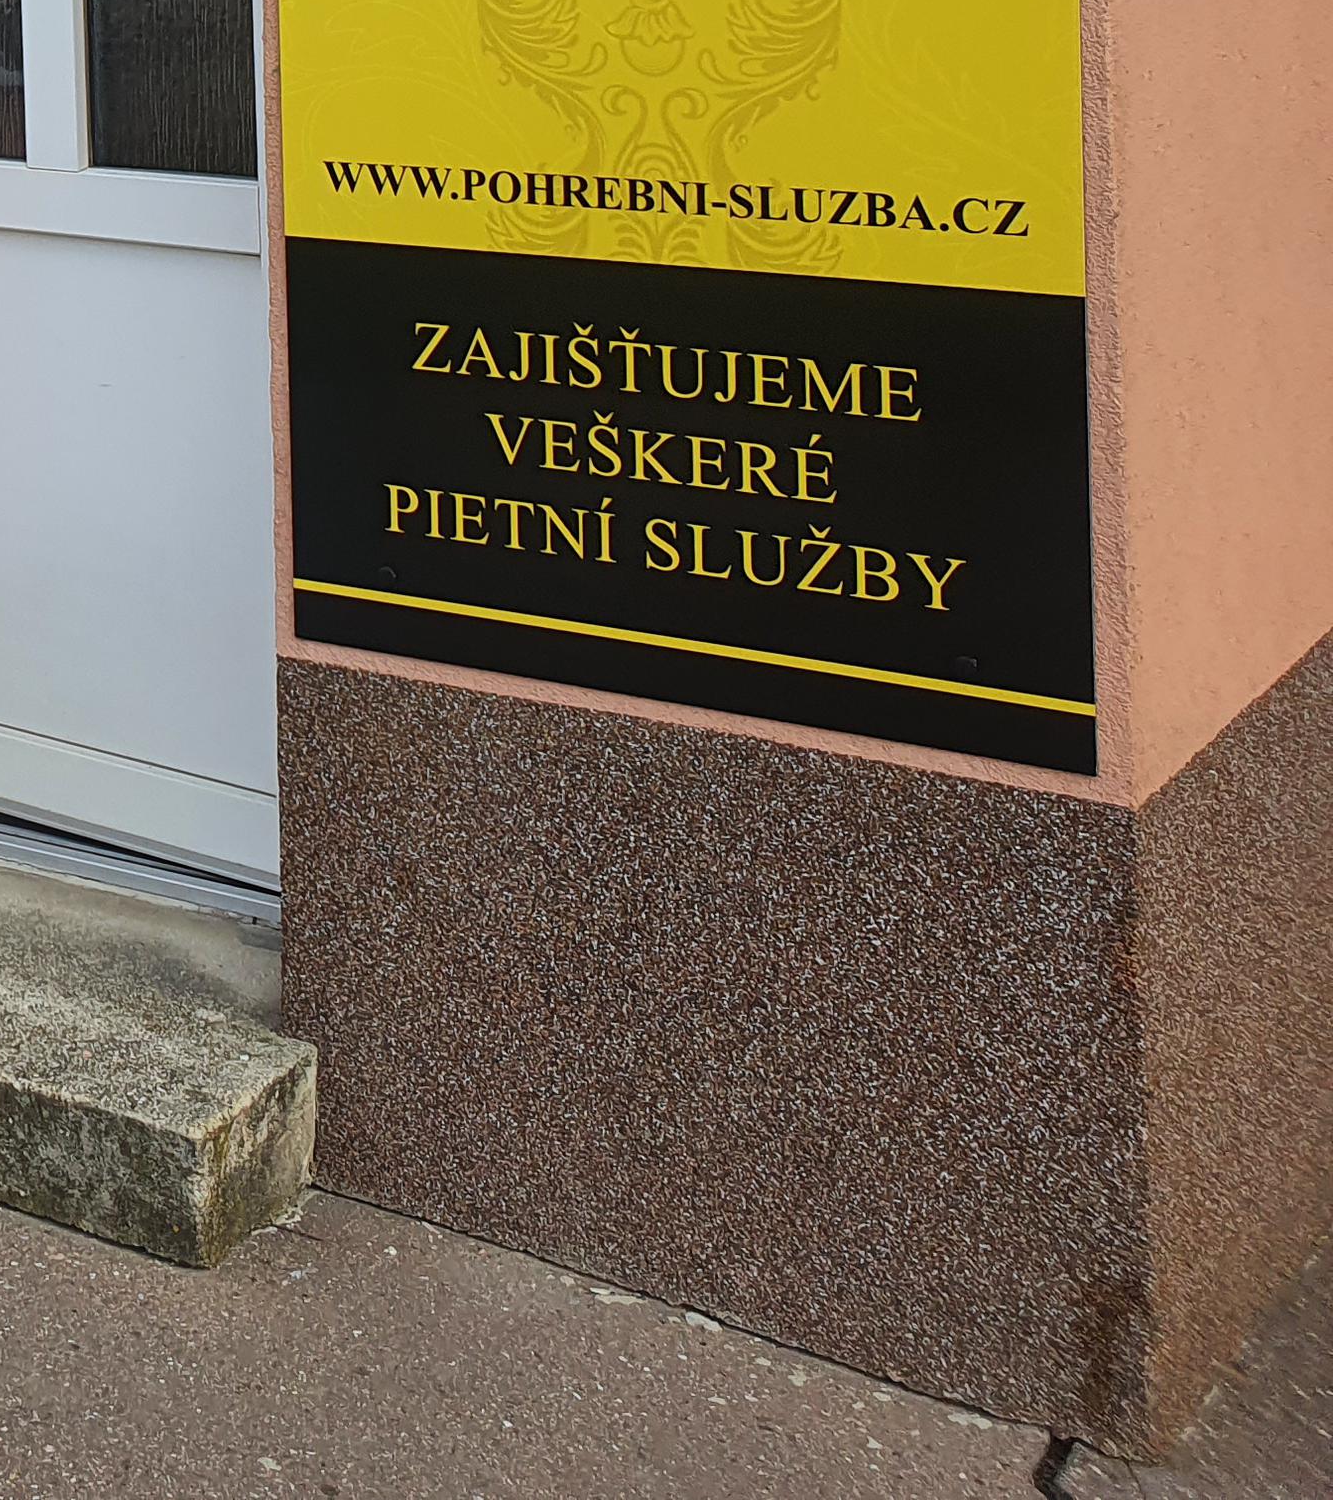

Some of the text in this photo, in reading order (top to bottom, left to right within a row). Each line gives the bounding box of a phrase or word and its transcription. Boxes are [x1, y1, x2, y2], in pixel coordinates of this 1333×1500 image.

[324, 161, 1029, 237] WWW.POHREBNI-SLUZBA.CZ
[412, 322, 922, 422] ZAJIŠŤUJEME
[485, 410, 837, 504] VEŠKERÉ
[383, 483, 967, 611] PIETNÍ SLUŽBY
